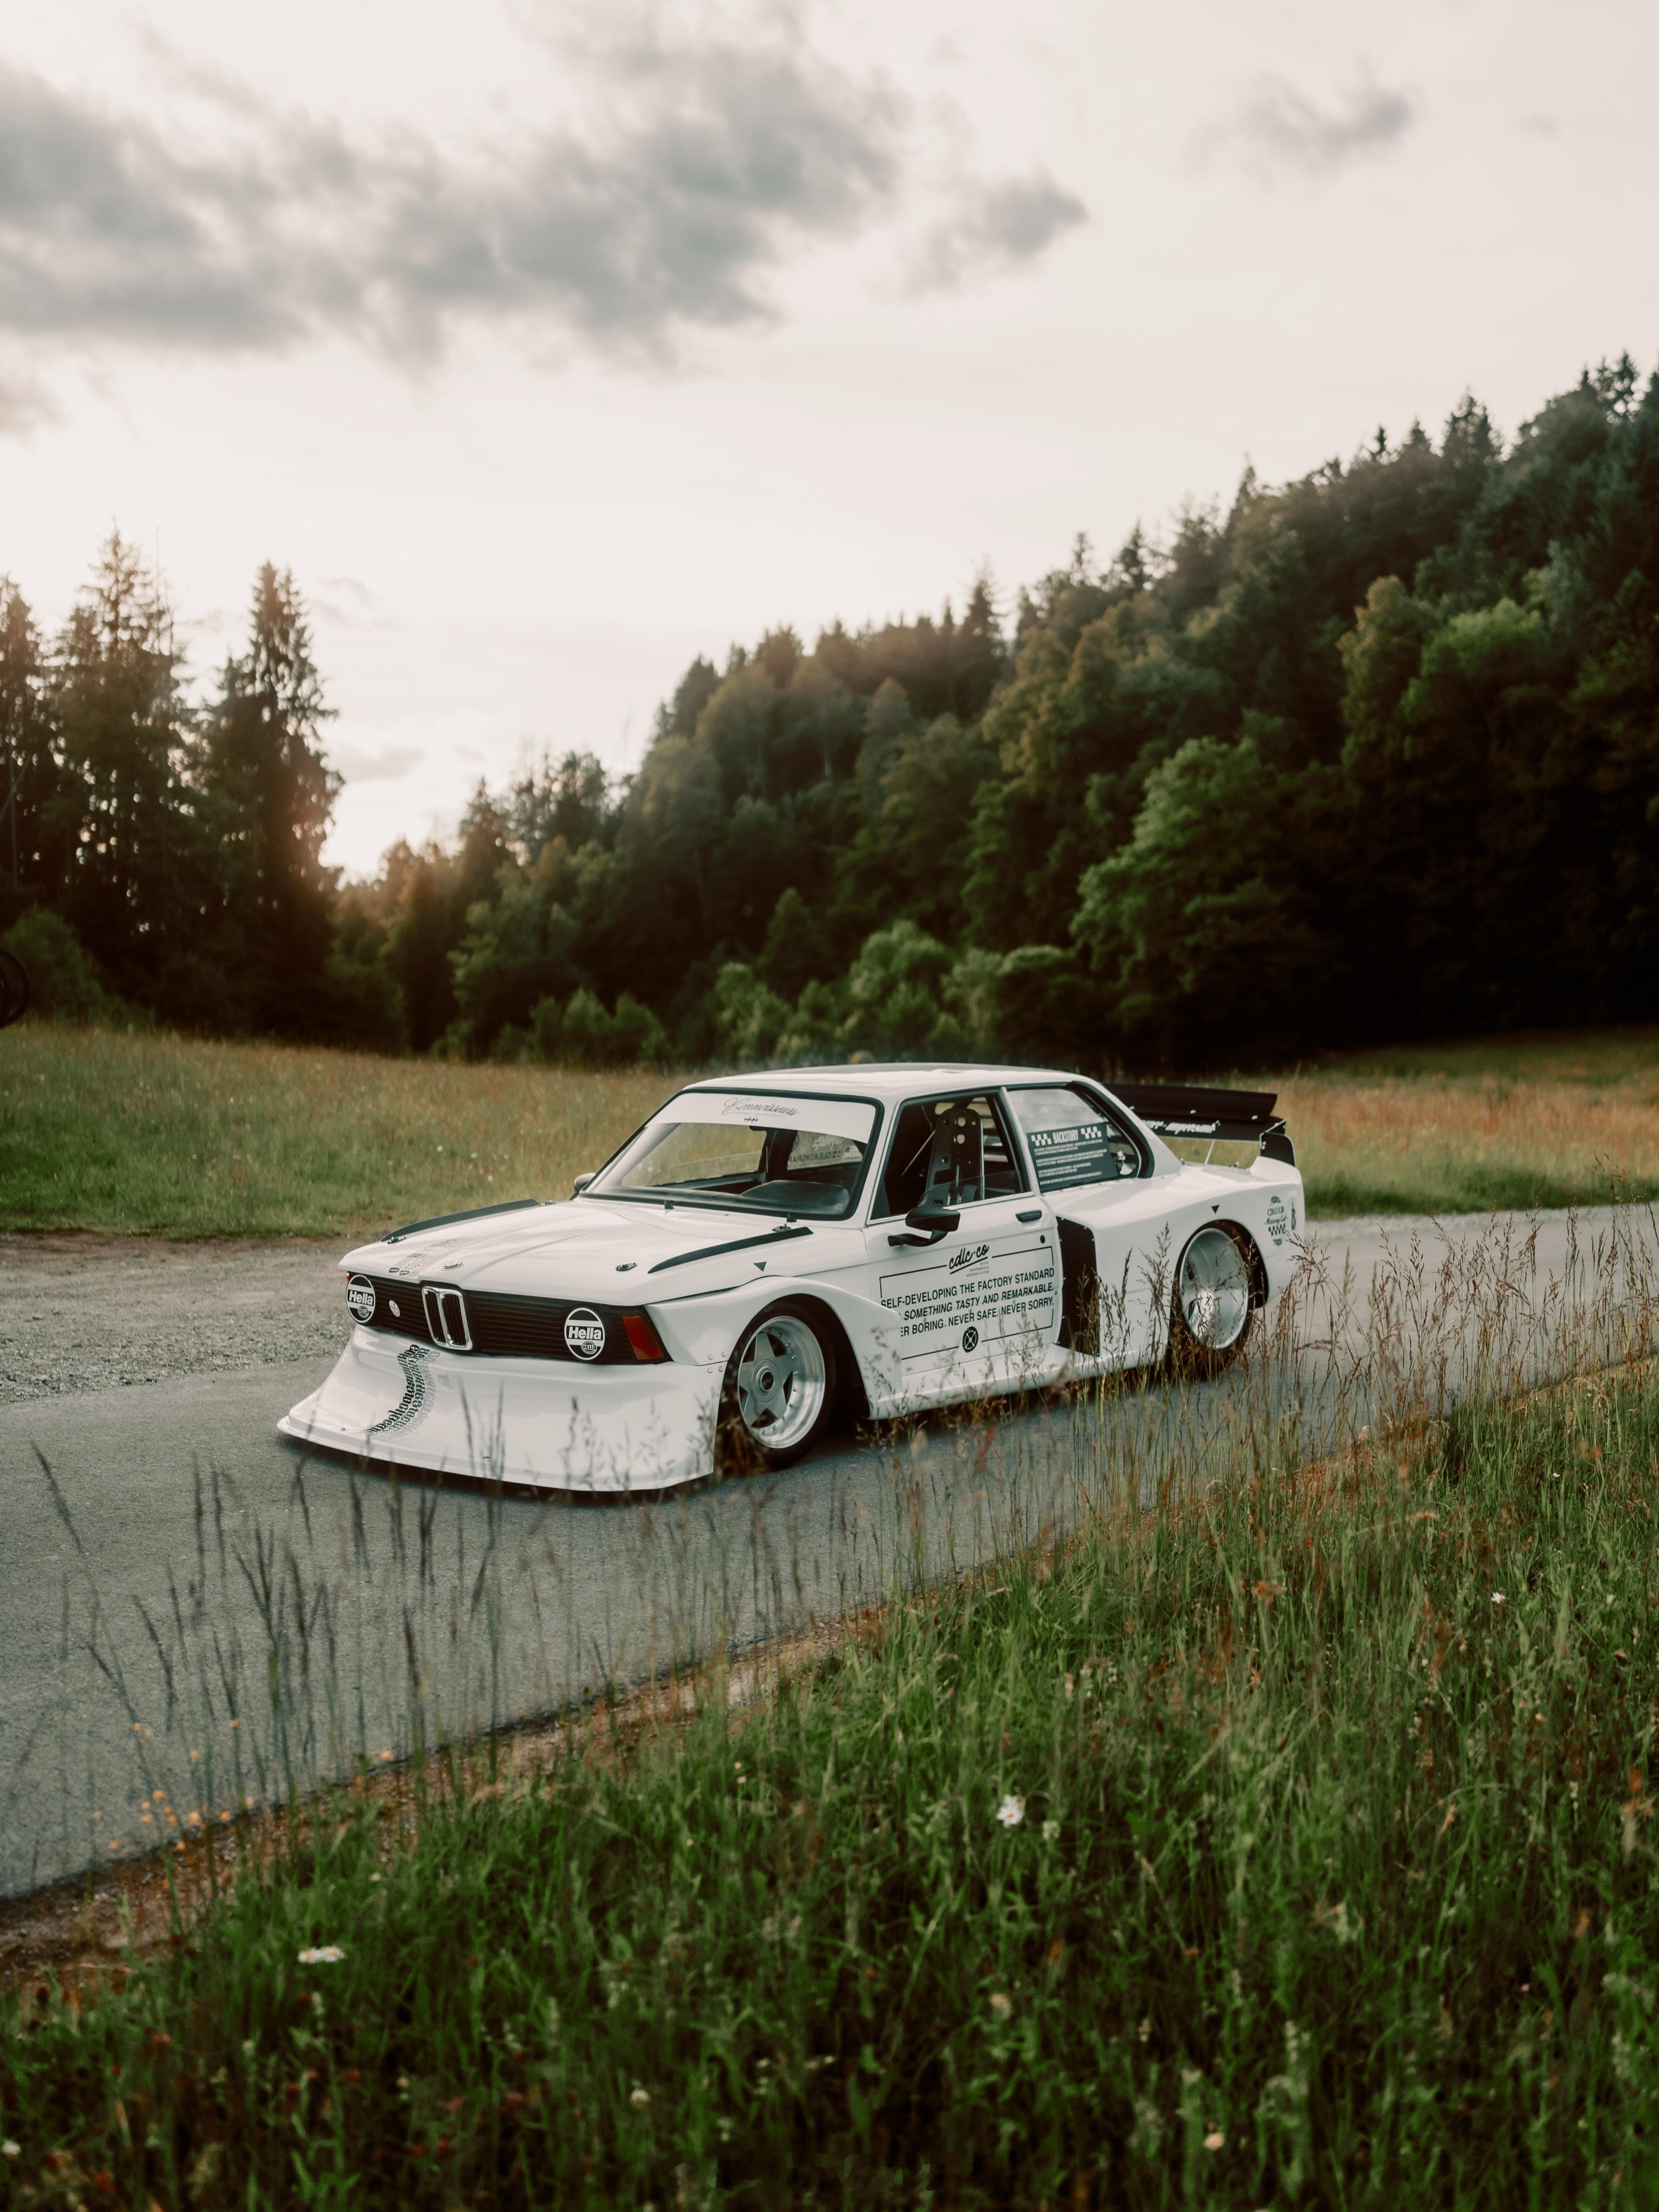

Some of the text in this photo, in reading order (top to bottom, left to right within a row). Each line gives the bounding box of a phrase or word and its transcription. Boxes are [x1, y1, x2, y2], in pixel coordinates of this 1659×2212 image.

[348, 1290, 373, 1306] Hella
[881, 1267, 1054, 1309] SELF-DEVELOPING THE FACTORY STANDARD
[904, 1282, 1054, 1320] SOMETHING TASTY AND REMARKABLE.
[568, 1326, 602, 1340] Hella
[912, 1319, 947, 1334] BORING.
[948, 1312, 975, 1326] NEVER
[976, 1308, 999, 1320] SAFE.
[1001, 1302, 1026, 1316] NEVER
[1028, 1296, 1054, 1310] SORRY.
